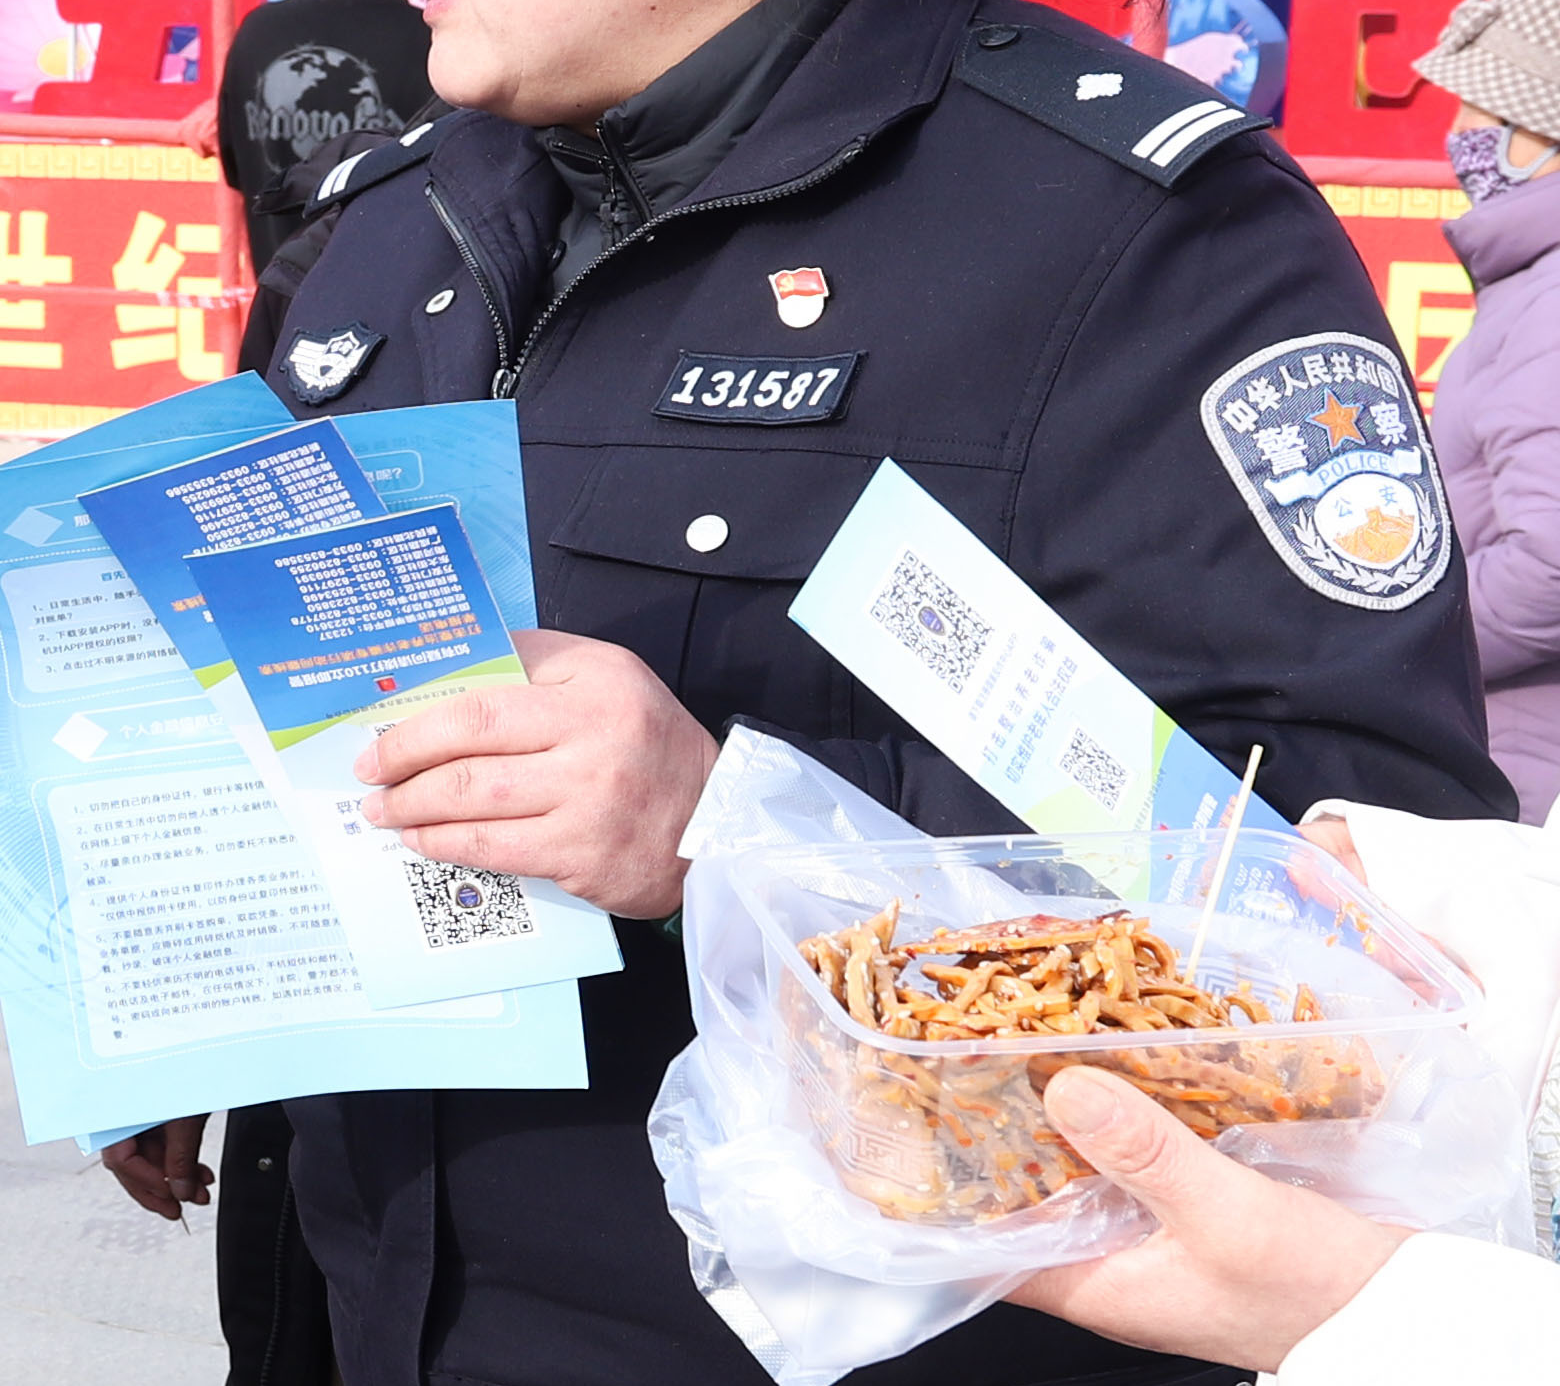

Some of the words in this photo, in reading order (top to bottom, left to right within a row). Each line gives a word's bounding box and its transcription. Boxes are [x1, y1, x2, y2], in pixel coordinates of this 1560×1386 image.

[671, 366, 841, 410] 131587
[1221, 351, 1400, 434] 中华人民共和国
[1253, 402, 1407, 475] 警察
[1317, 454, 1389, 487] POLICE
[1334, 485, 1398, 517] 公安
[288, 642, 470, 687] 如有疑问请拨打110立即报警
[980, 634, 1057, 765] 打击整治养老诈骗
[1000, 655, 1080, 785] 切实维护老年人合法权益
